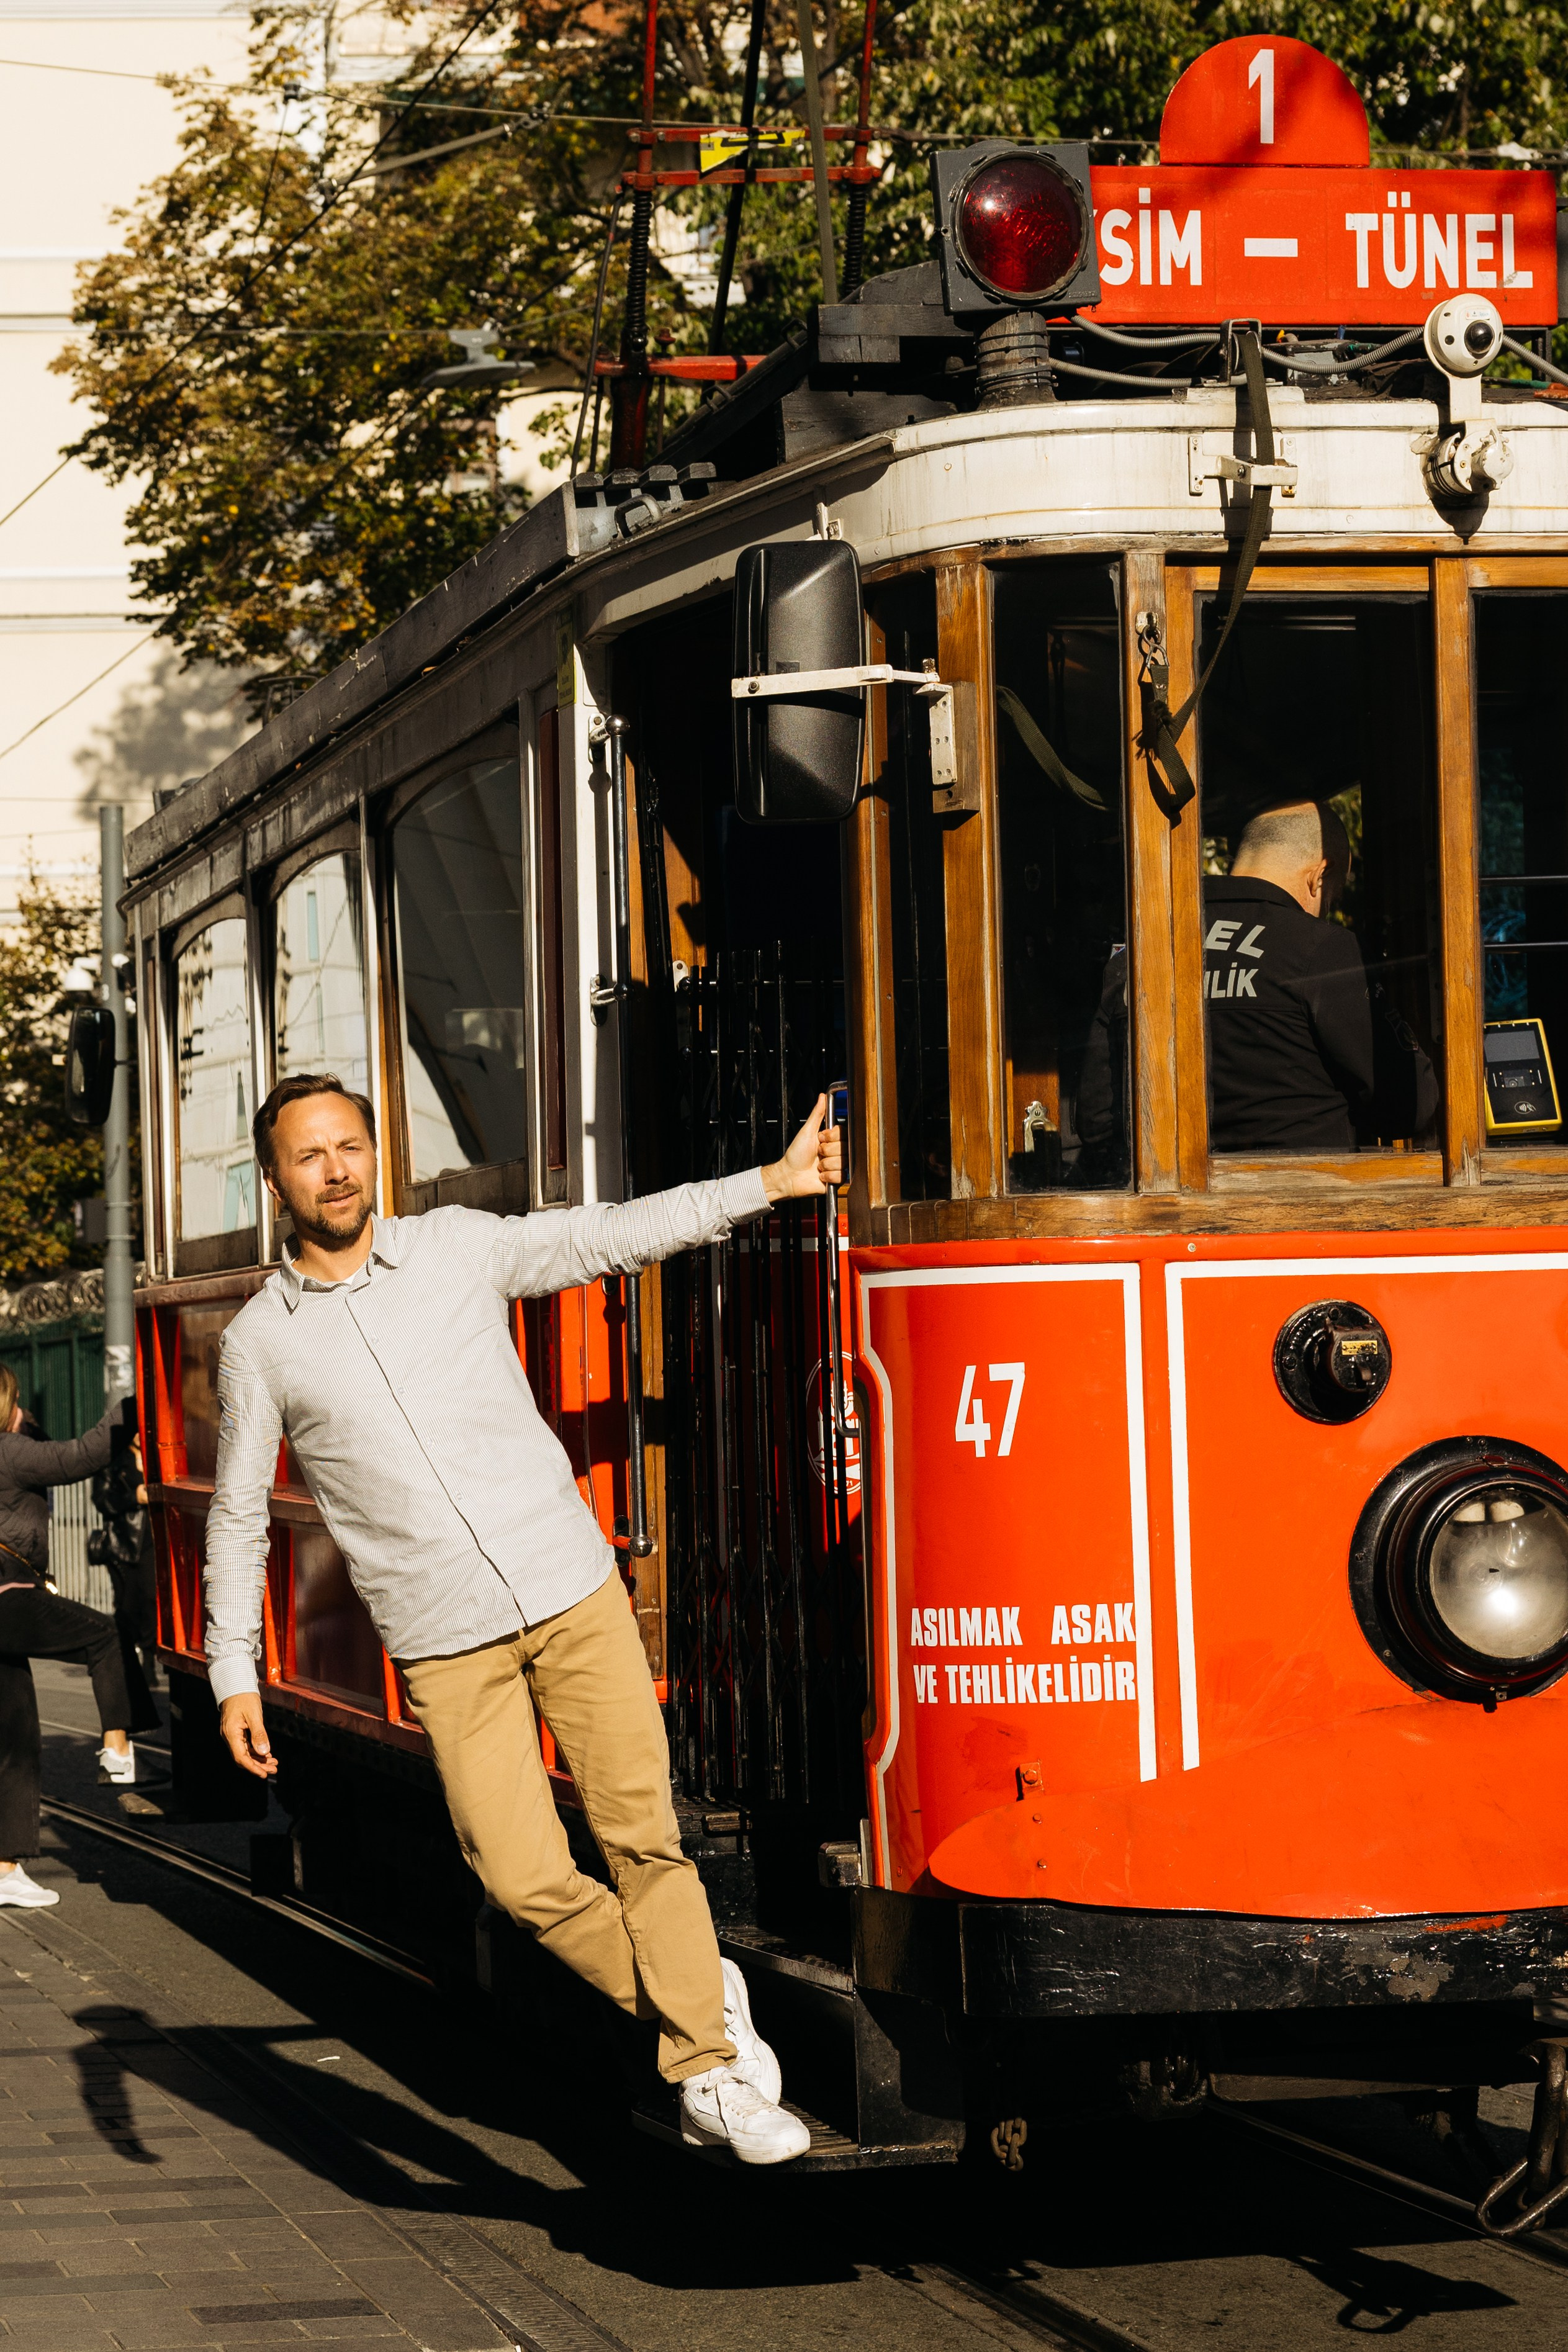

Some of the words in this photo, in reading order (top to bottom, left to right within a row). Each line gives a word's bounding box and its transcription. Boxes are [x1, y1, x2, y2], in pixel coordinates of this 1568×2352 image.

[1248, 48, 1274, 144] 1
[1093, 187, 1202, 286] SİM
[1345, 191, 1533, 289] TÜNEL
[1202, 920, 1266, 958] EL
[1204, 962, 1259, 998] LİK
[955, 1362, 1025, 1458] 47
[911, 1606, 1023, 1647] ASILMAK
[1051, 1603, 1136, 1644] ASAK
[913, 1665, 938, 1703] VE
[945, 1654, 1136, 1704] TEHLİKELİDİR
